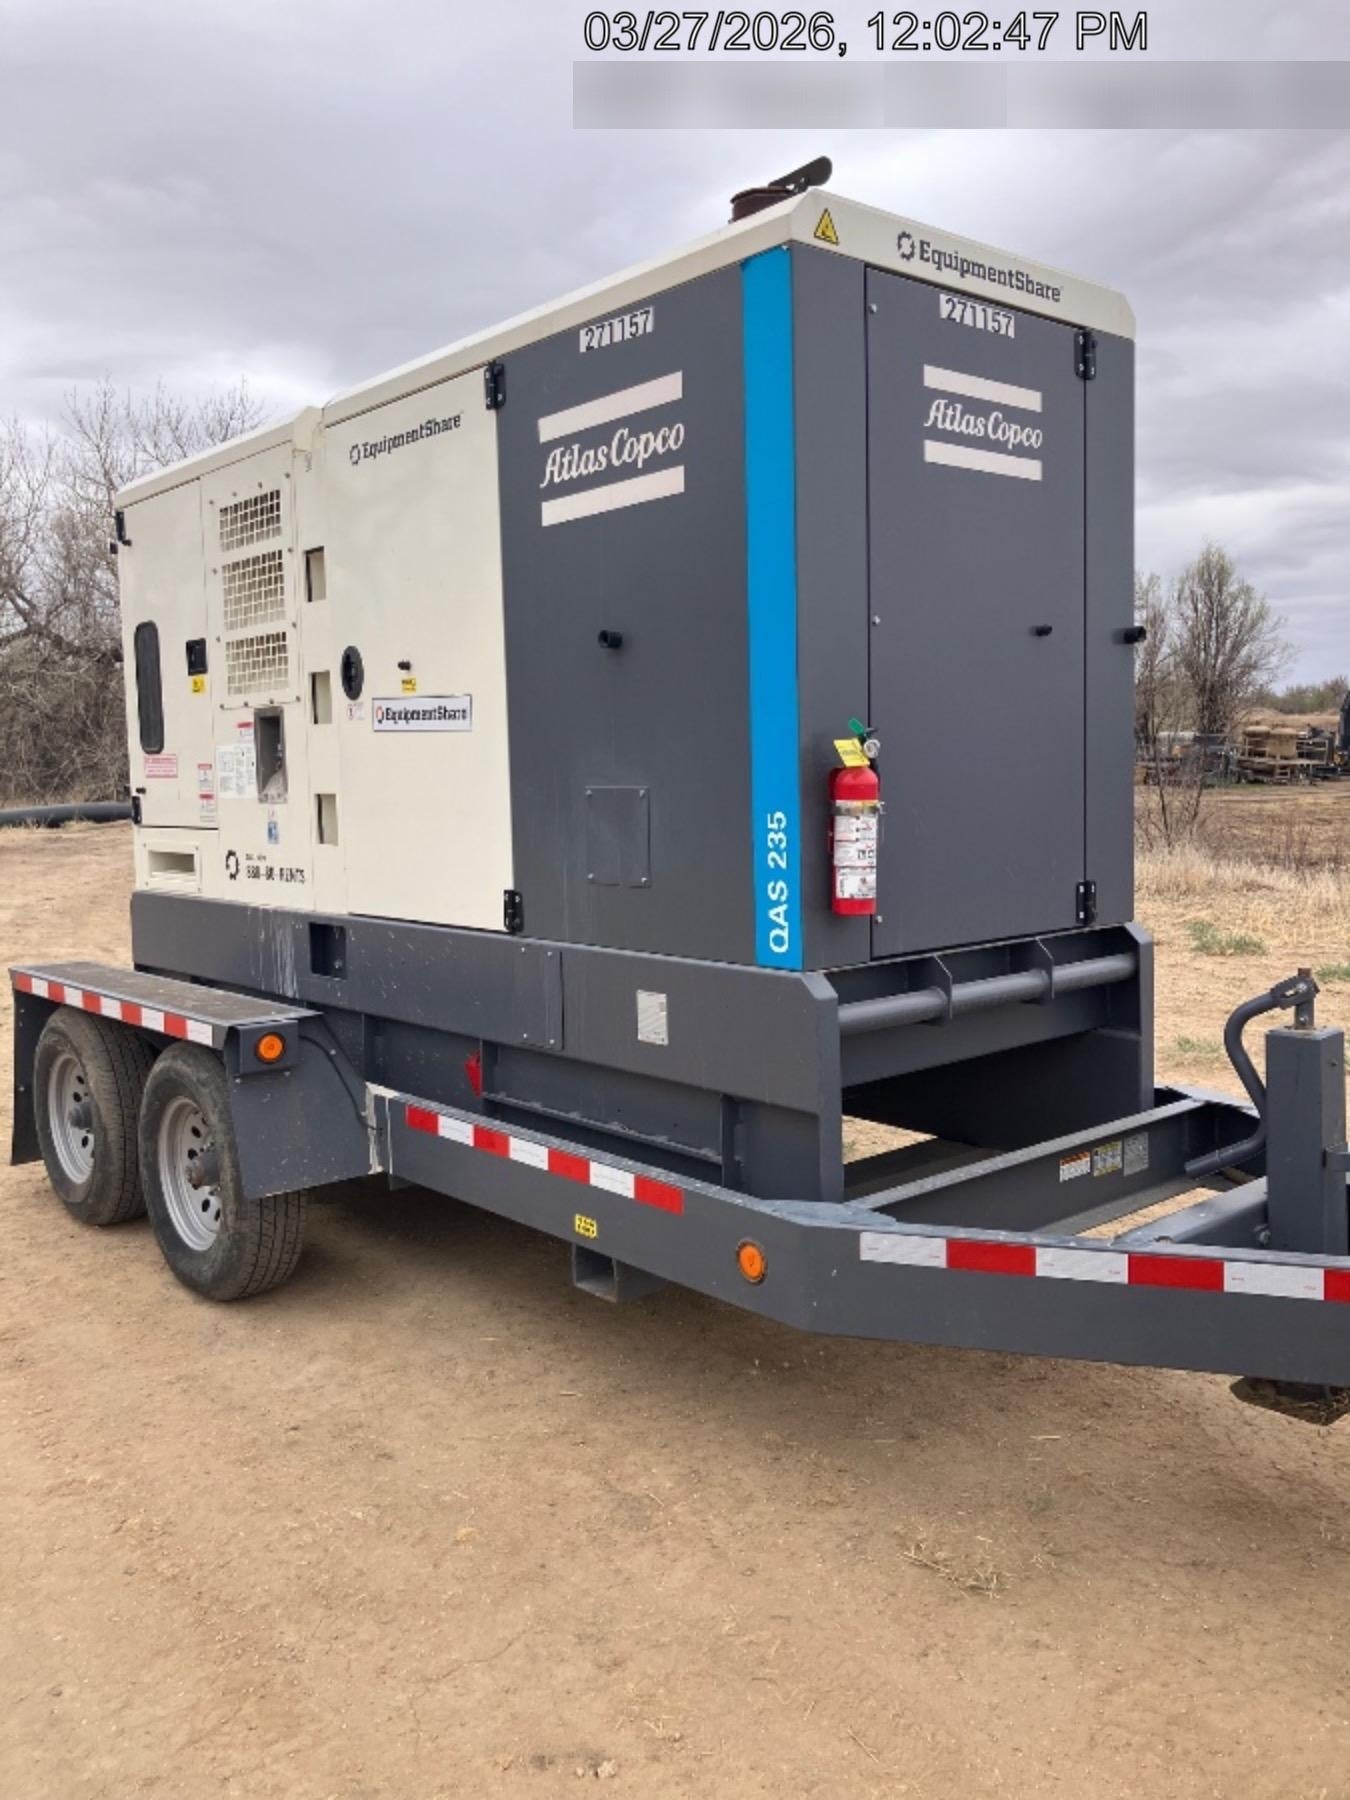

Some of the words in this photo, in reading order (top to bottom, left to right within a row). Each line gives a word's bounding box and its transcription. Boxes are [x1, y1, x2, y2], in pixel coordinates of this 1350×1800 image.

[919, 239, 1061, 302] EquipmentShare
[584, 309, 652, 352] 271157
[944, 296, 1014, 338] 271157
[362, 414, 461, 460] EquipmentShare
[923, 399, 985, 437] Atlas
[987, 411, 1043, 450] Copco
[539, 443, 608, 489] Atlas
[610, 422, 685, 469] Copco
[767, 811, 787, 870] 235
[768, 879, 789, 953] QAS
